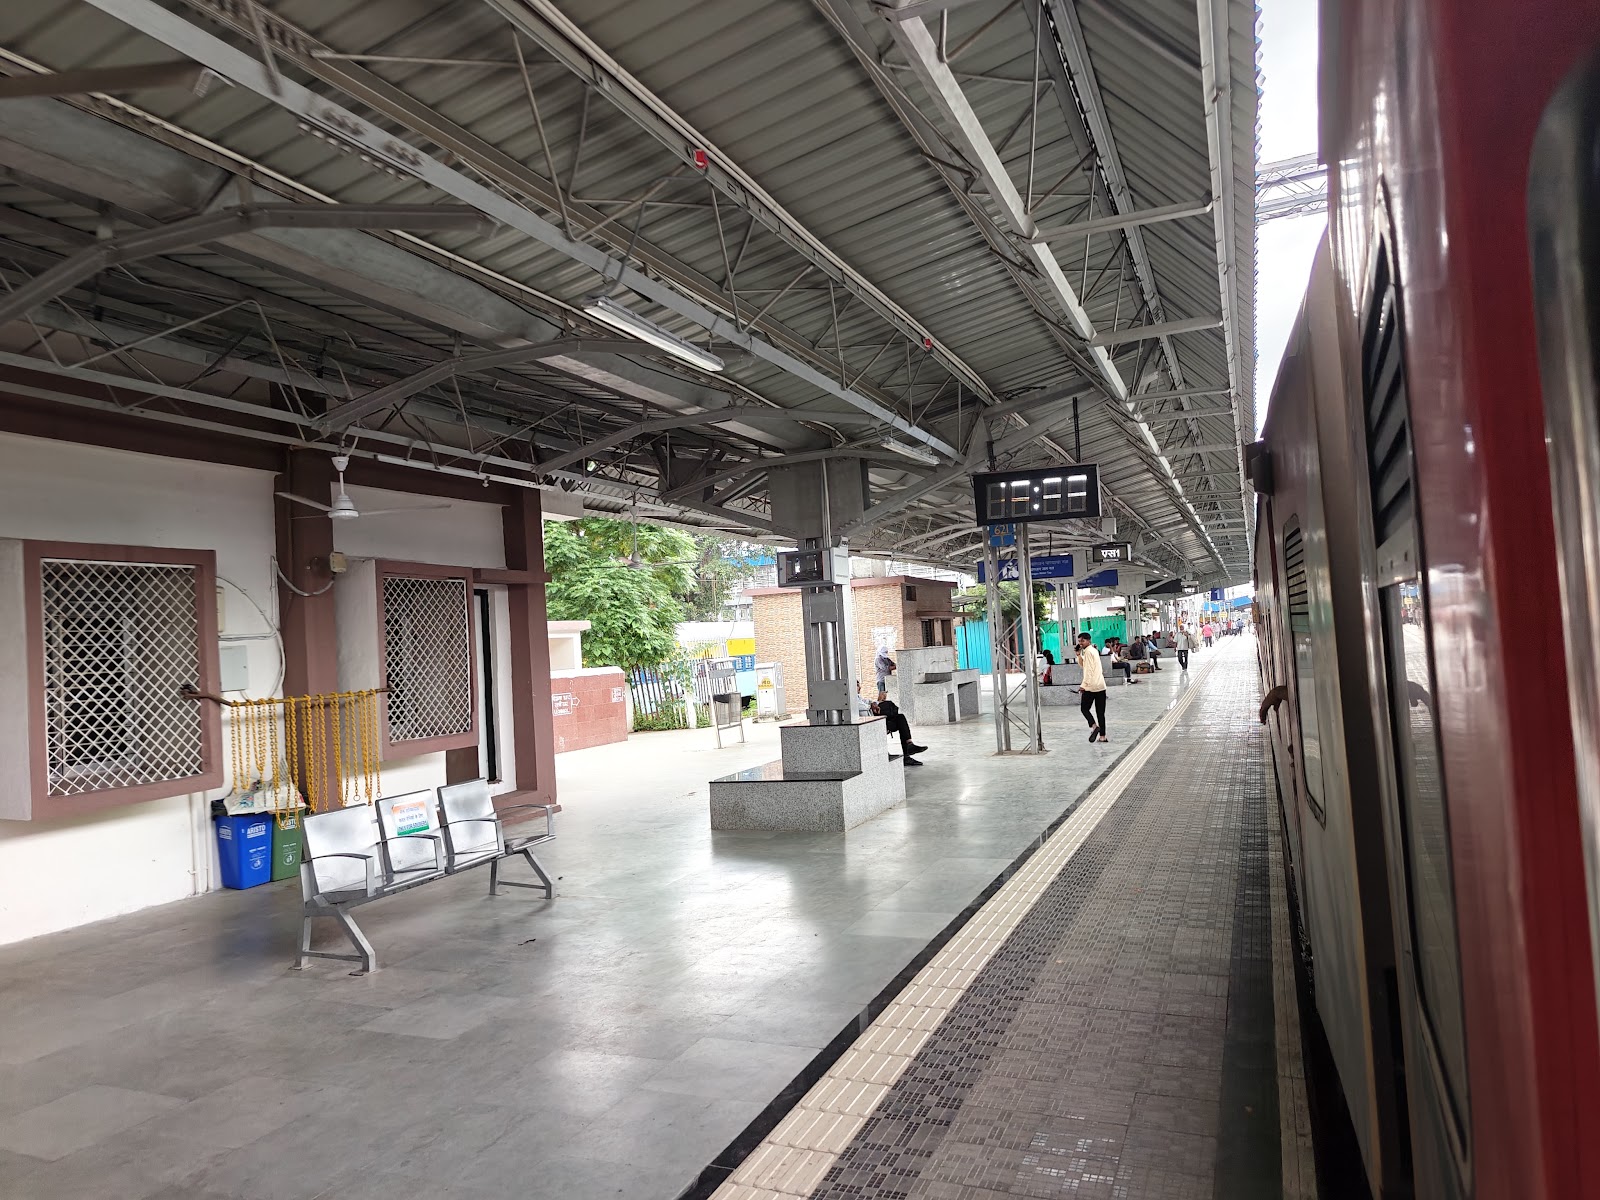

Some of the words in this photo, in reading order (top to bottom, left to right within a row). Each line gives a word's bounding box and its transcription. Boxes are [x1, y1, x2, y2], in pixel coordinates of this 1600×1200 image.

[994, 524, 1009, 535] 621
[1214, 588, 1220, 600] 1
[247, 825, 266, 834] ARISTO
